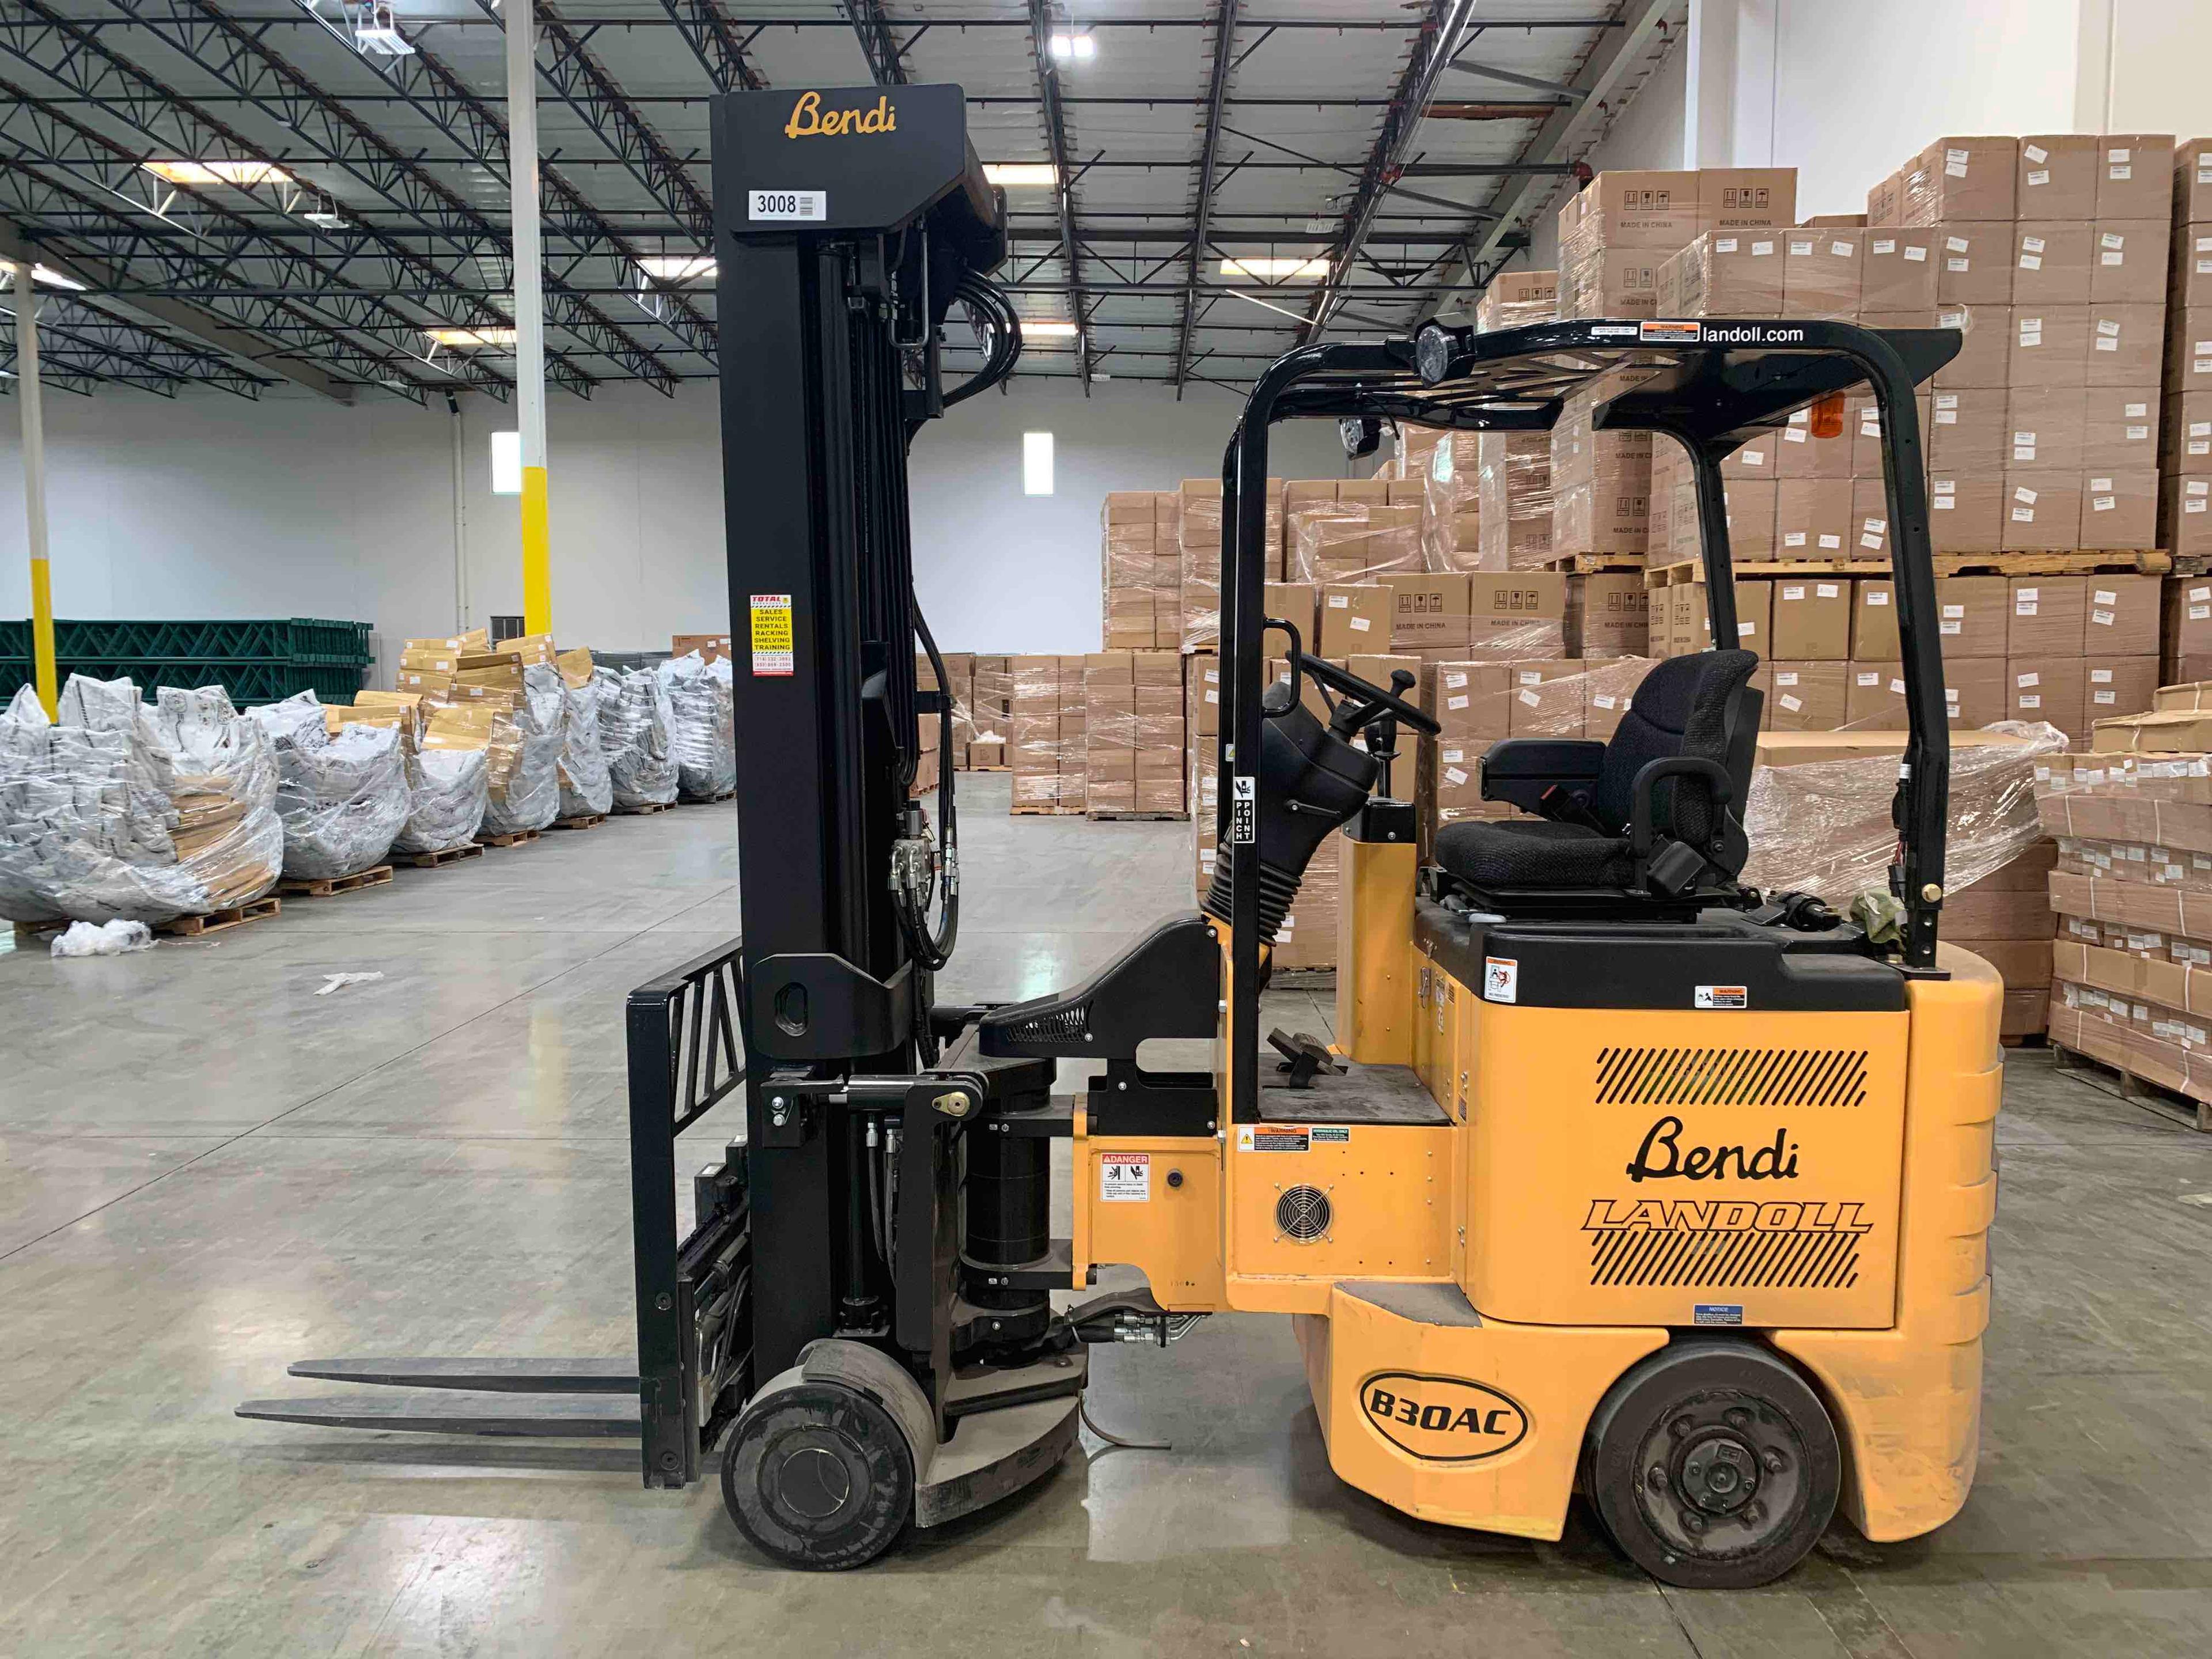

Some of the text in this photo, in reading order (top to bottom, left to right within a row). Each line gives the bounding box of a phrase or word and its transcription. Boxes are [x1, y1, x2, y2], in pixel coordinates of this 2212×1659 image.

[784, 91, 897, 139] Bendi
[757, 195, 796, 213] 3008
[1703, 326, 1804, 342] landoll.com
[1111, 1155, 1147, 1164] DANGER
[1626, 1116, 1799, 1183] Bendi
[1580, 1199, 1874, 1233] LANDOLL
[1370, 1388, 1511, 1435] B30AC
